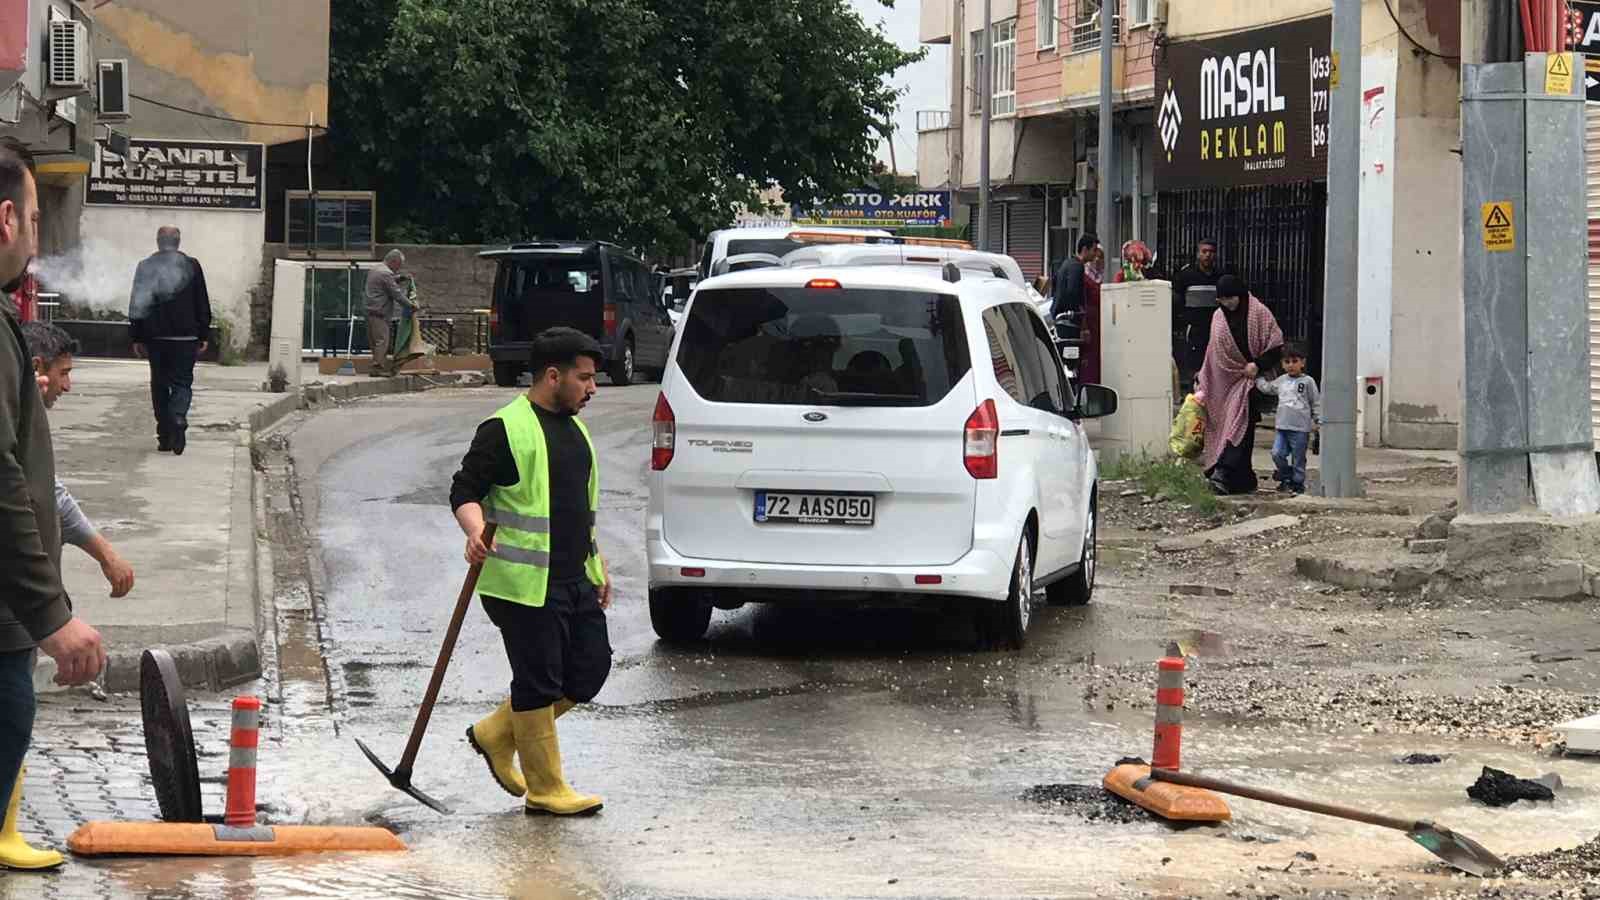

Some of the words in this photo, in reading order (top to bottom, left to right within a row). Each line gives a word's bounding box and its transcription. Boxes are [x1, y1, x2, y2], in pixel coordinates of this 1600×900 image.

[1200, 47, 1285, 120] MASAL
[1313, 89, 1328, 112] 771
[1200, 121, 1285, 160] REKLAM
[889, 193, 942, 207] PARK
[827, 209, 865, 218] YIKAMA
[874, 209, 895, 219] OTO
[687, 439, 753, 448] TOURNEO
[767, 496, 790, 516] 72
[798, 497, 871, 518] AAS050
